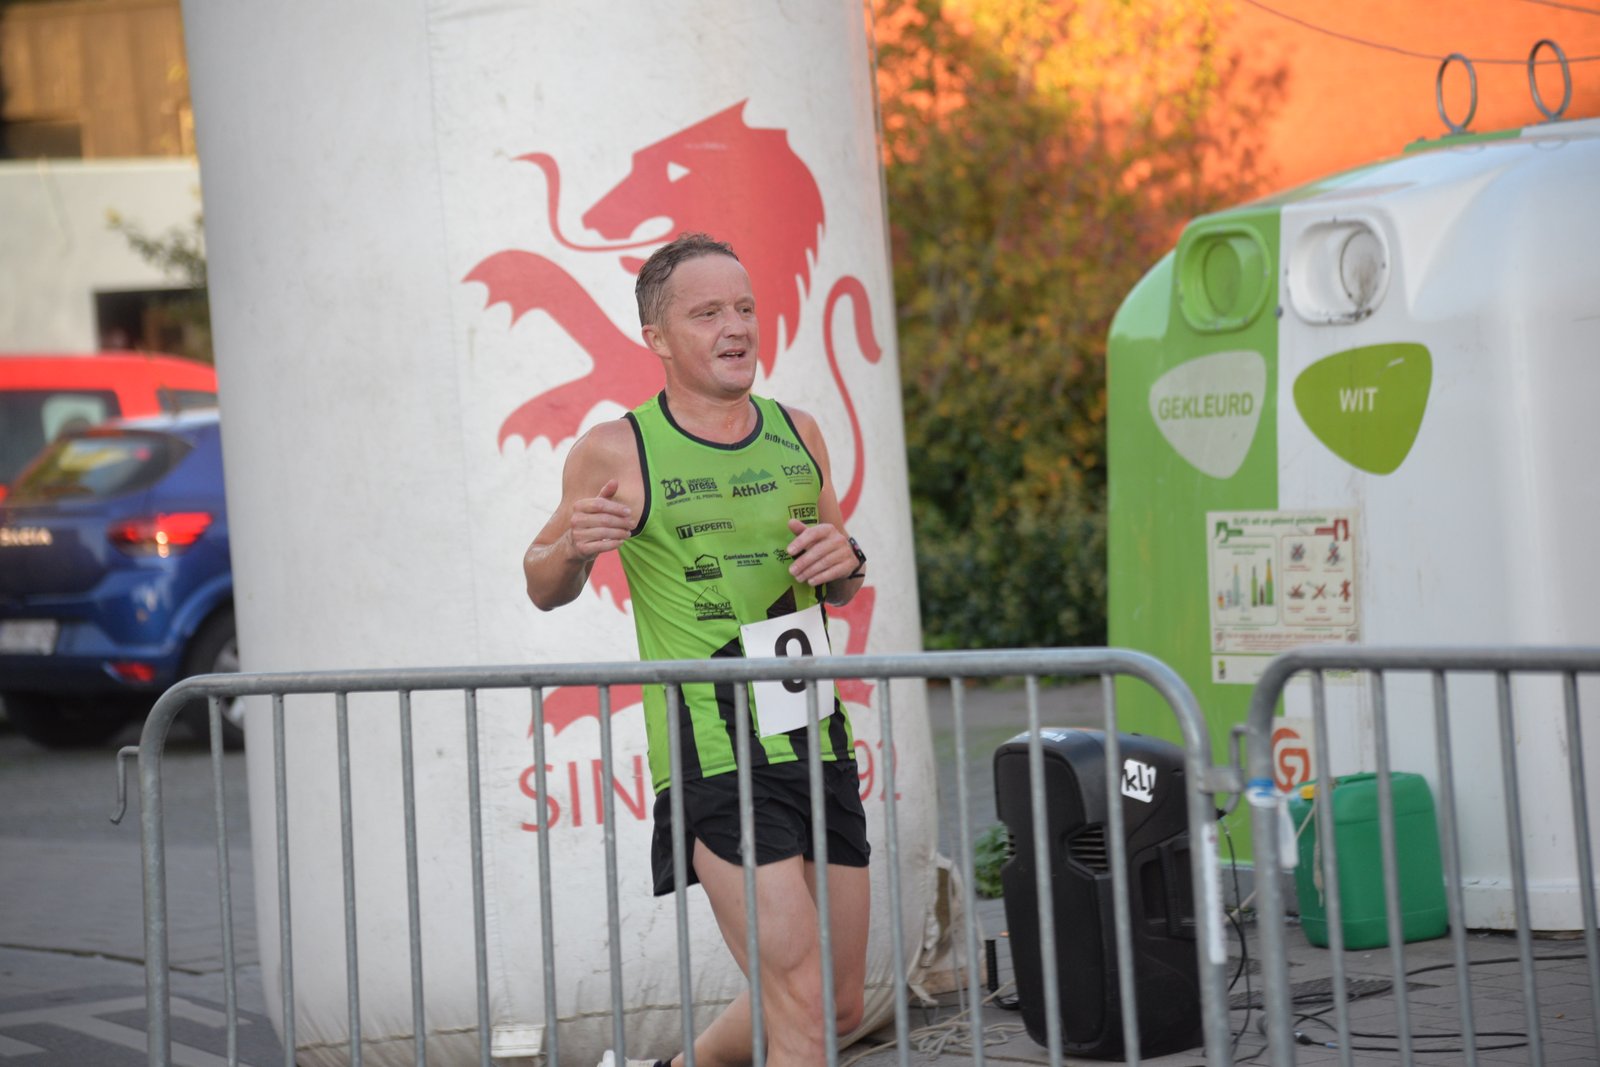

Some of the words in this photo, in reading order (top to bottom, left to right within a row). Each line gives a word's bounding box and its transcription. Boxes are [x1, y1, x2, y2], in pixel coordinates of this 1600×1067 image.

[1157, 392, 1254, 421] GEKLEURD
[1338, 386, 1379, 413] WIT
[688, 482, 718, 494] press
[731, 480, 779, 498] Athlex
[694, 521, 733, 534] EXPERTS
